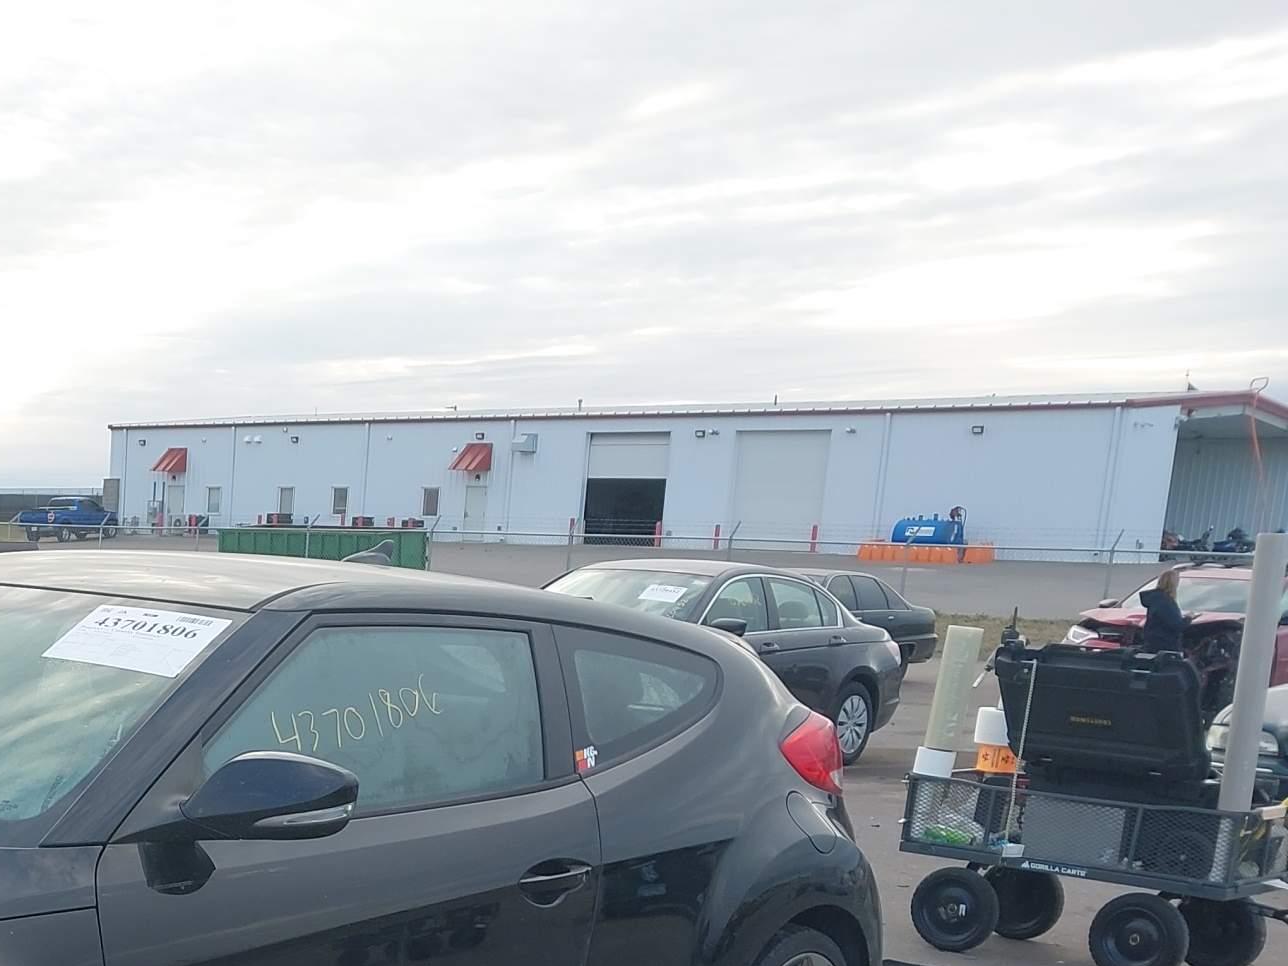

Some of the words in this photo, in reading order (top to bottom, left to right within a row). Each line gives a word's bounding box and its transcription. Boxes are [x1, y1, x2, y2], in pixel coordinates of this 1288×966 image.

[94, 616, 199, 640] 43701806
[271, 673, 444, 752] 43701806
[1030, 862, 1060, 873] GORILLA
